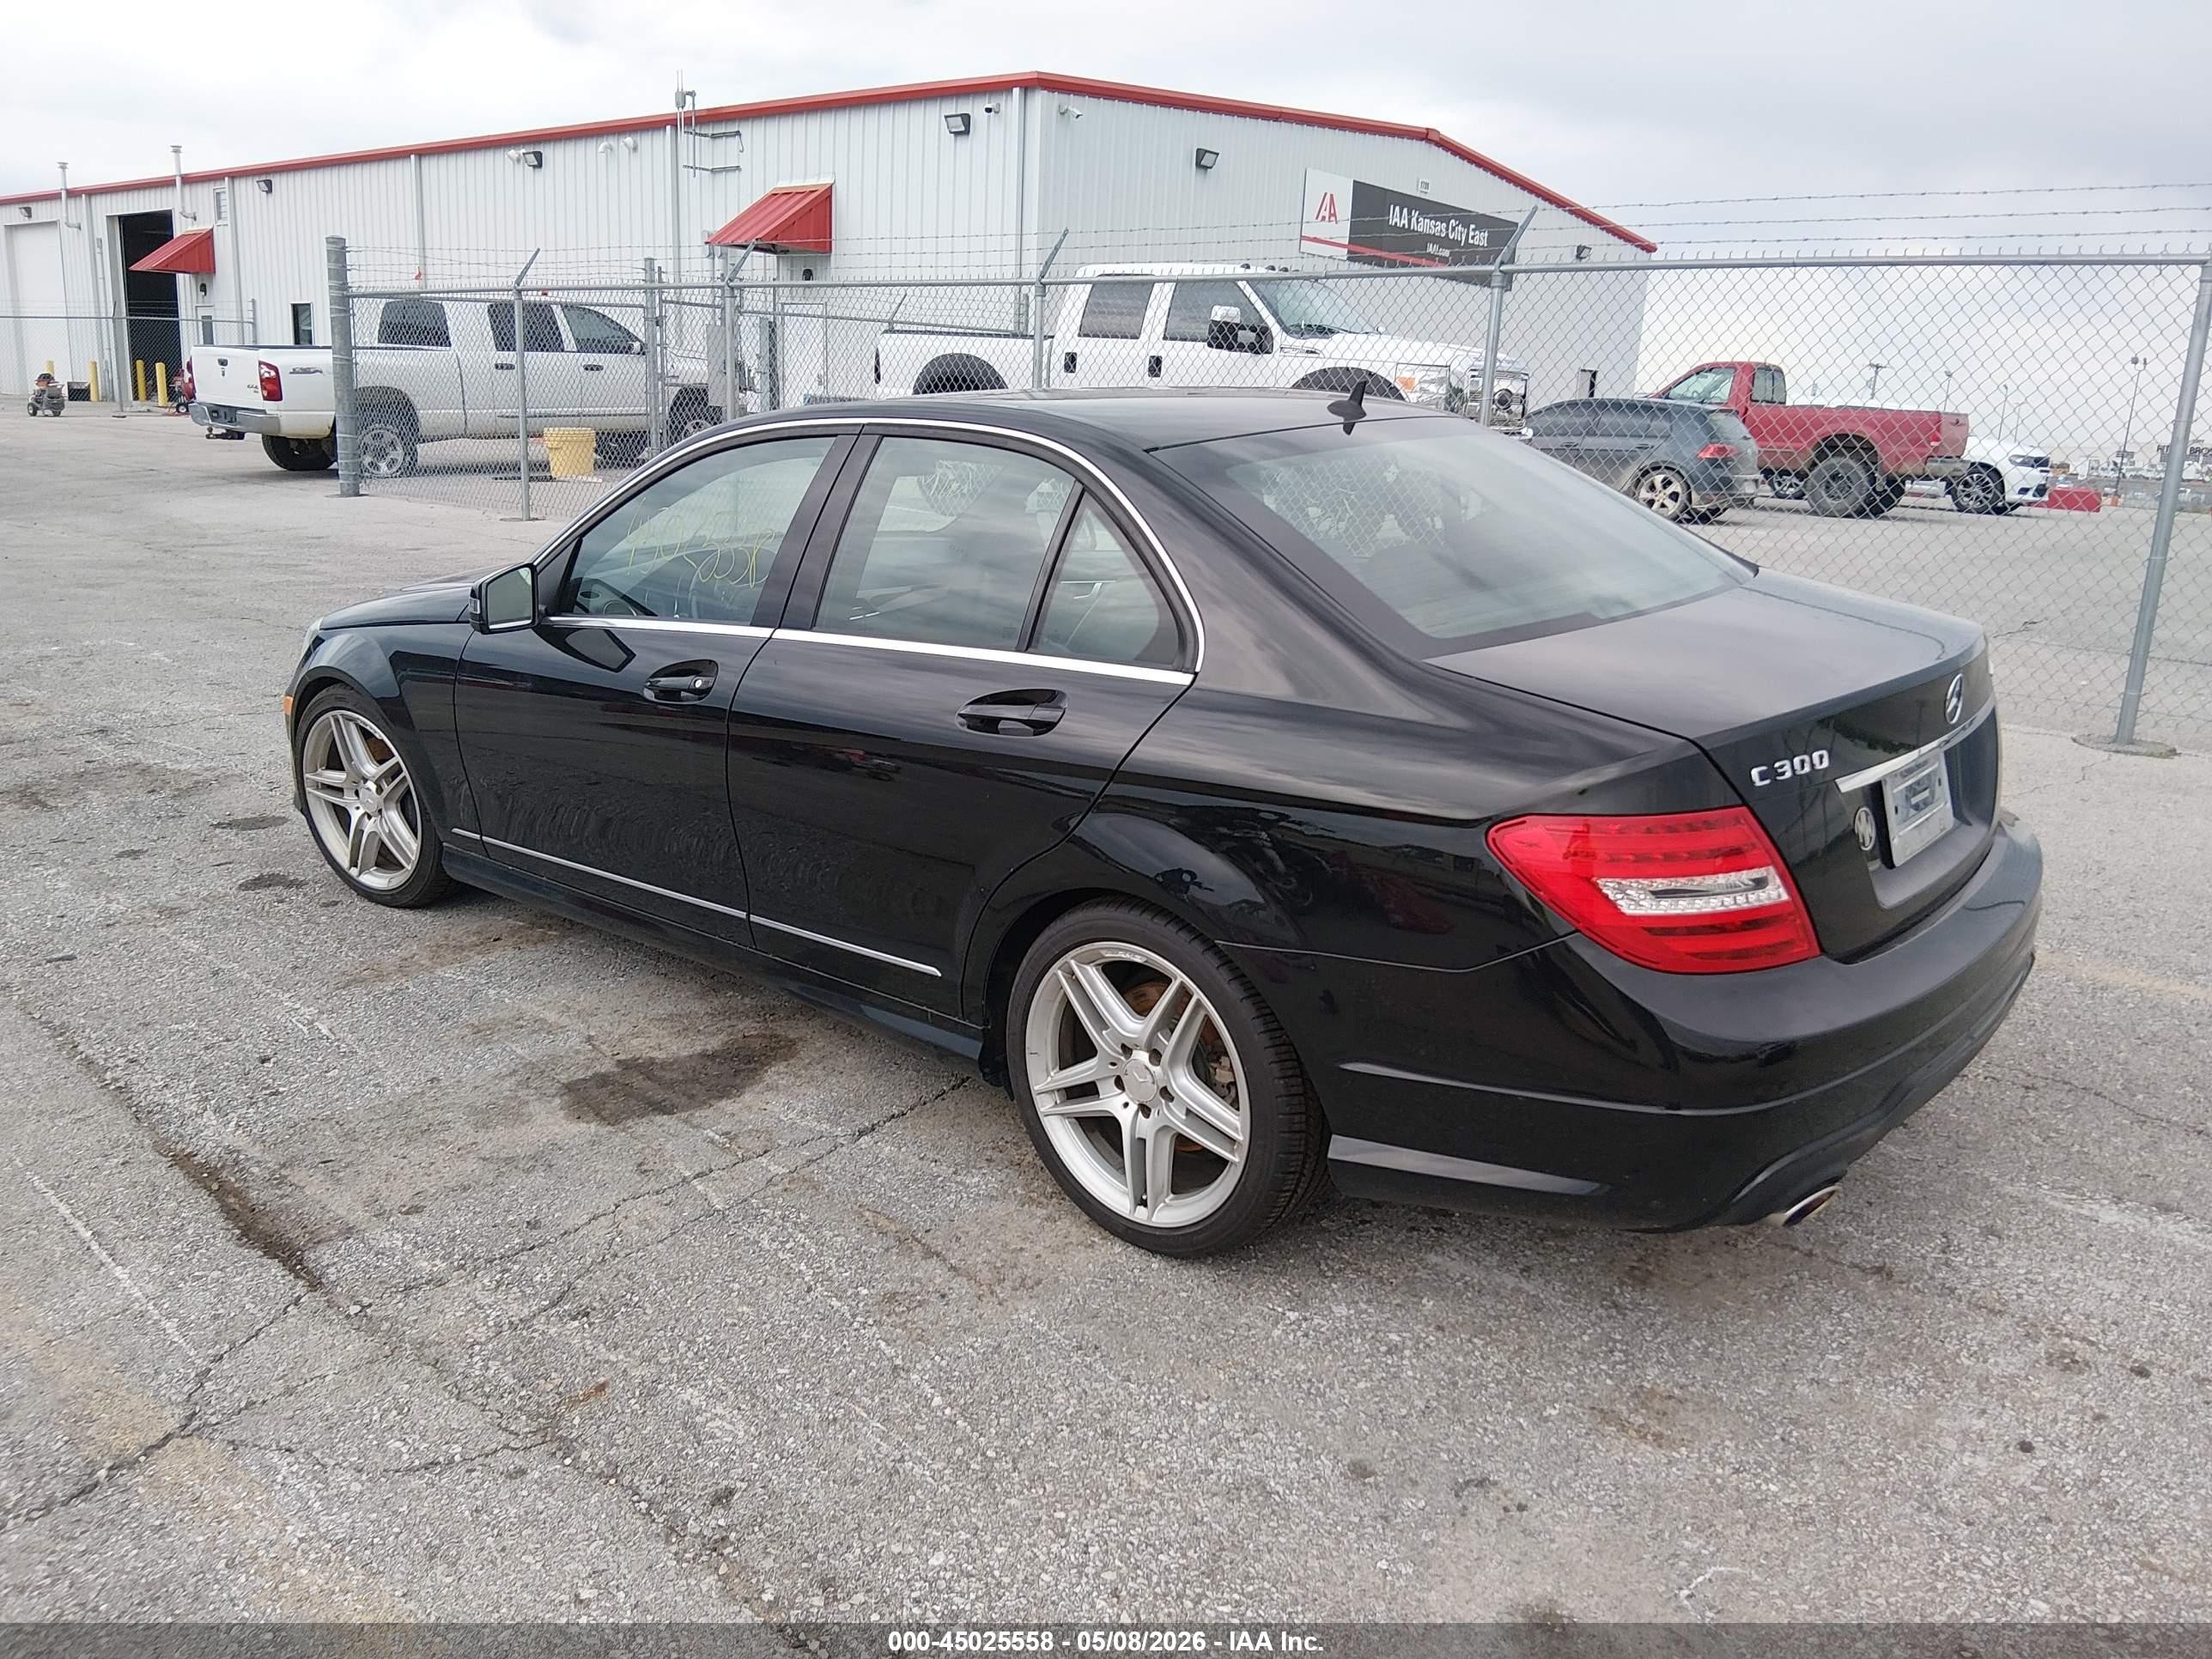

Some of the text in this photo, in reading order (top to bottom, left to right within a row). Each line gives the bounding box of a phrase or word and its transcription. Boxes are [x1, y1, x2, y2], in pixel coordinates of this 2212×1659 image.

[1389, 204, 1489, 247] IAA Kansas City East
